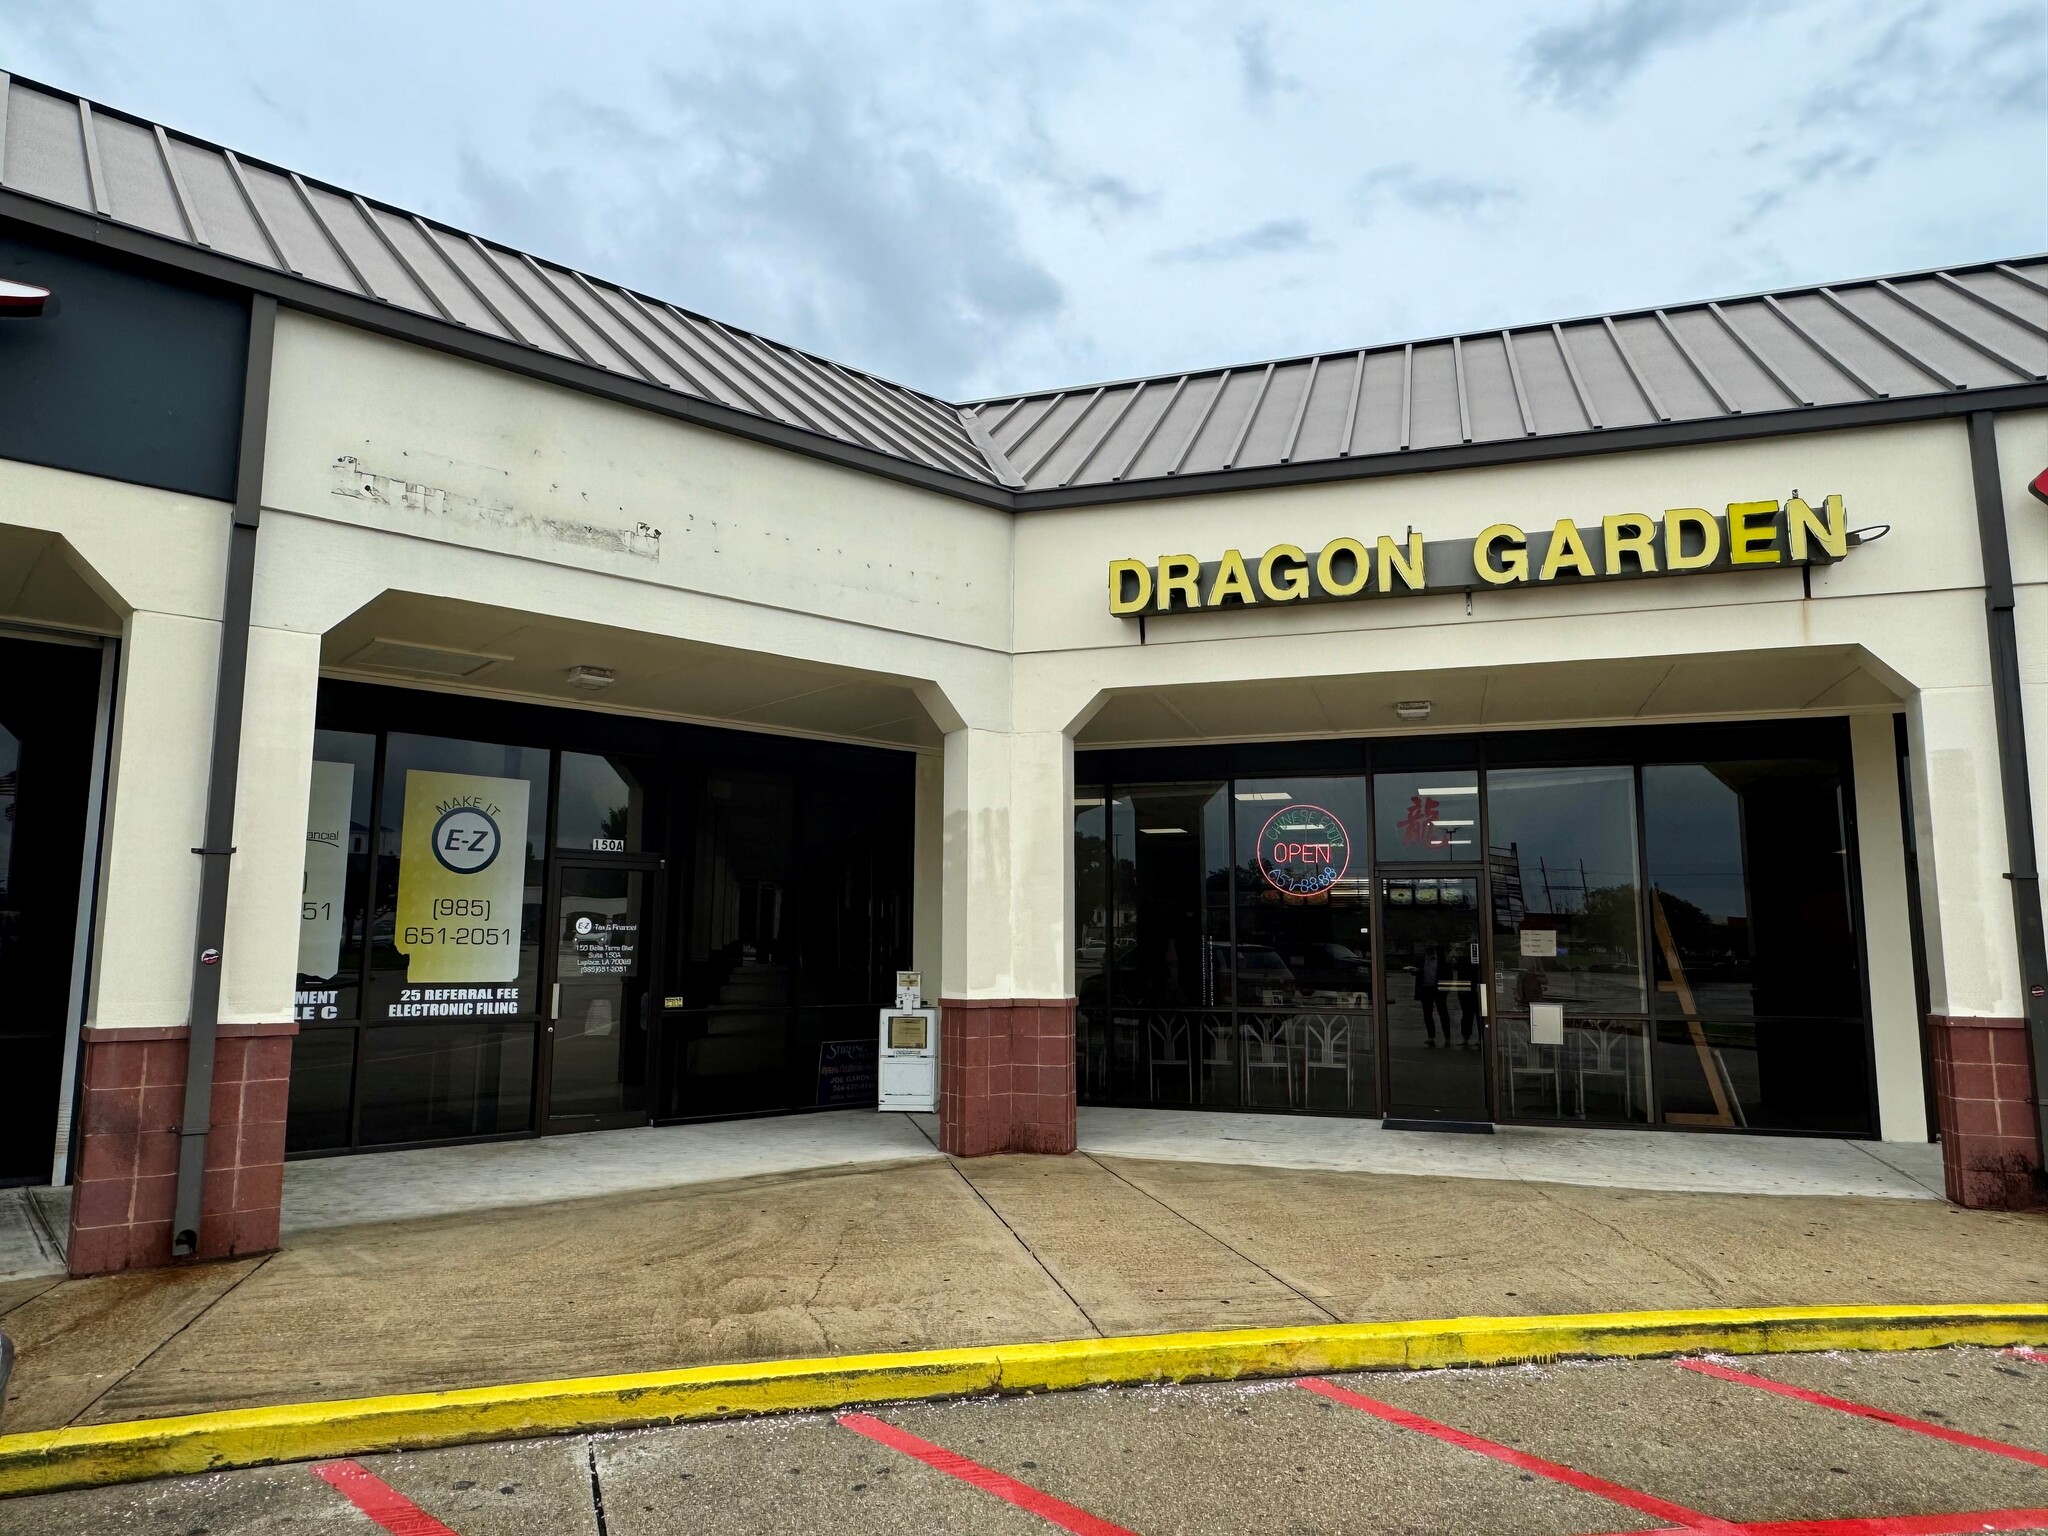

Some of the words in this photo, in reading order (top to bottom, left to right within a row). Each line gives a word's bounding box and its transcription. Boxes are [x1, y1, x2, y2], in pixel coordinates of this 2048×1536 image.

[1108, 531, 1426, 616] DRAGON
[1473, 494, 1848, 584] GARDEN
[435, 795, 483, 816] MAKE
[485, 802, 501, 817] IT
[1266, 809, 1318, 840] CHINESE
[1320, 815, 1344, 846] FOOD
[1397, 796, 1449, 848] 龍
[444, 828, 489, 852] E-Z
[594, 840, 623, 851] 150A
[1273, 842, 1331, 864] OPEN
[433, 898, 490, 921] (985)
[404, 927, 511, 946] 651-2051
[612, 923, 637, 931] Financial
[576, 944, 588, 952] 150
[400, 989, 420, 1001] 25
[424, 988, 493, 1001] REFERRAL
[496, 988, 519, 1000] FEE
[320, 1005, 338, 1020] C
[388, 1003, 474, 1017] ELECTRONIC
[476, 1002, 518, 1015] FILING
